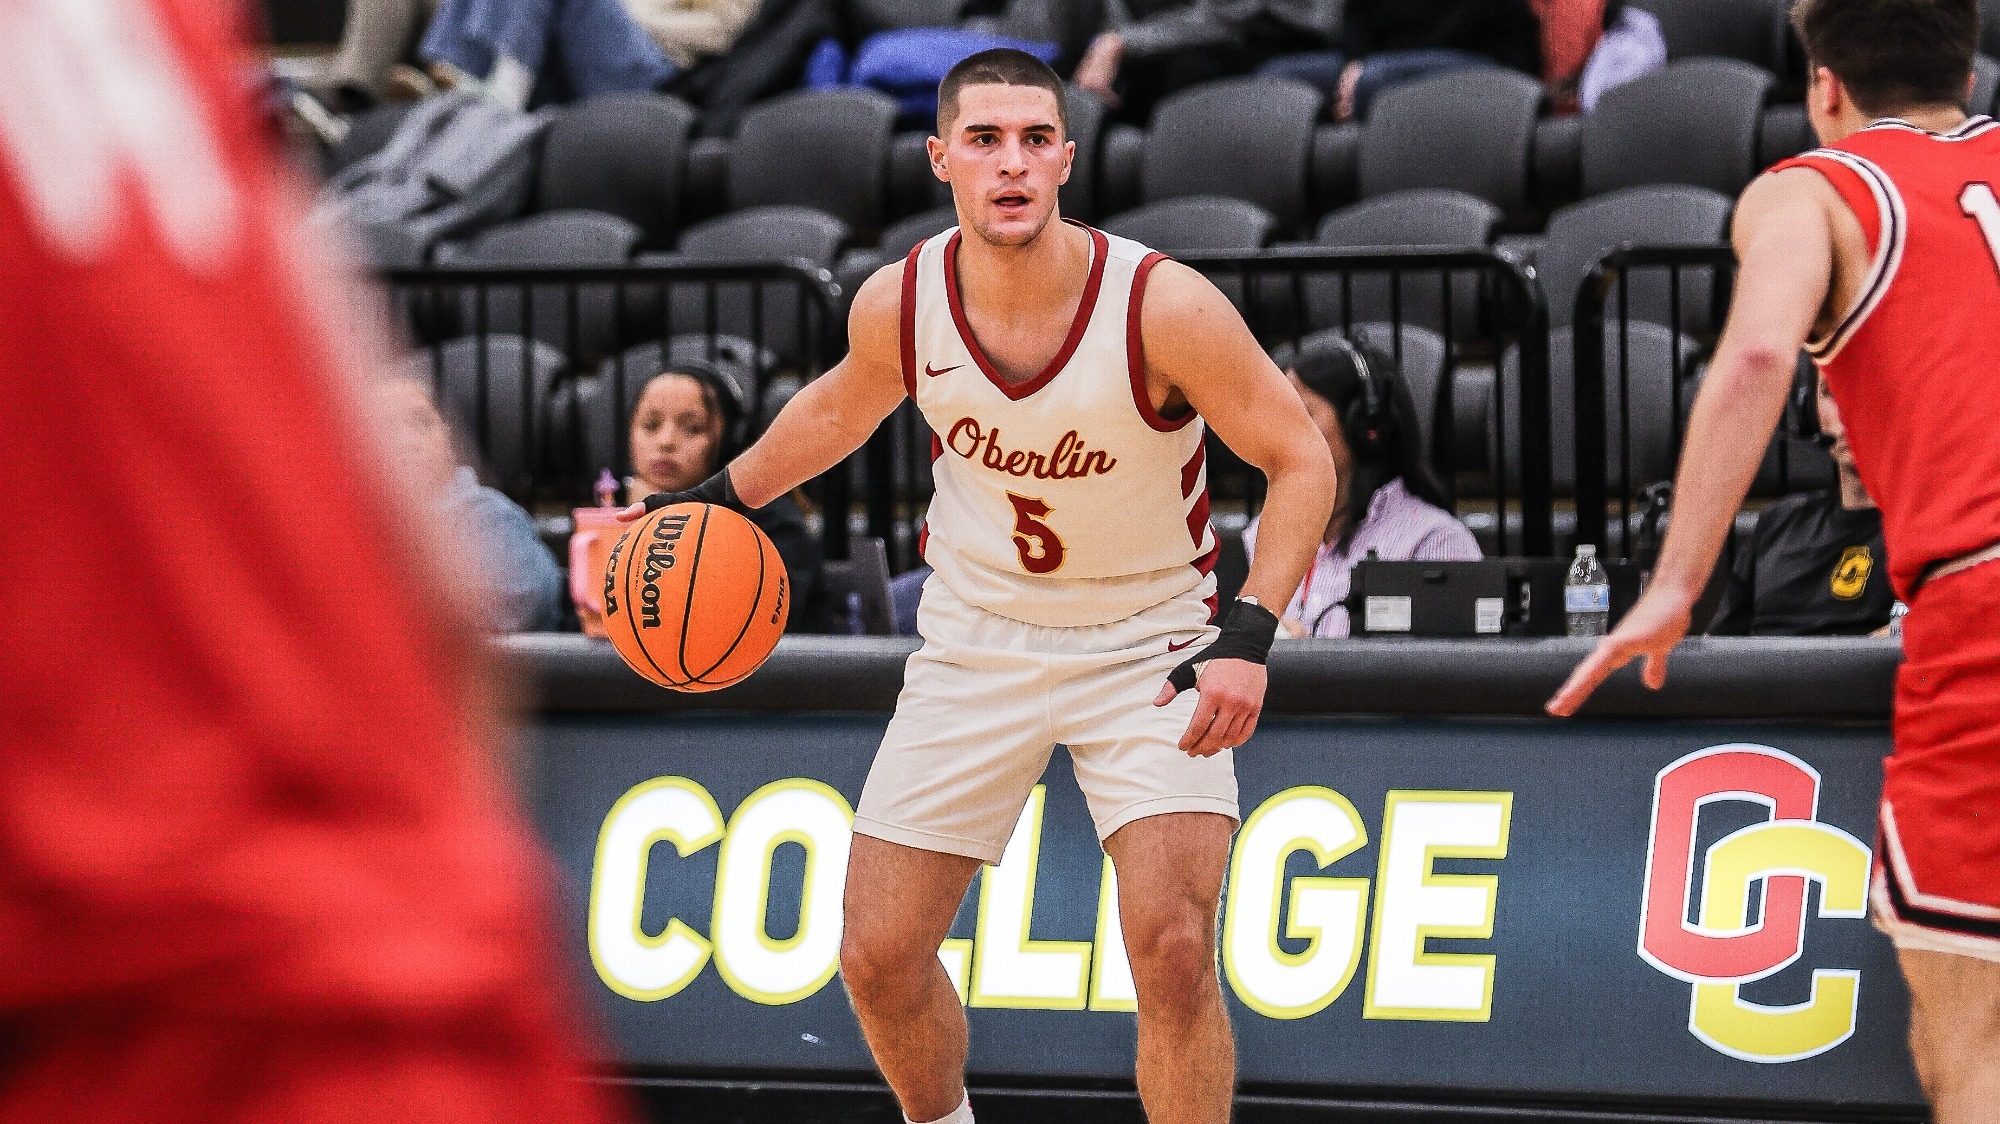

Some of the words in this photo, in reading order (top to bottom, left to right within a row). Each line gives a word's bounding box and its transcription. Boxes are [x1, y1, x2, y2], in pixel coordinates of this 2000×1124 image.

[946, 416, 1118, 480] Oberlin
[641, 513, 692, 630] Wilson
[1005, 489, 1069, 574] 5
[588, 775, 1514, 1022] COLGE
